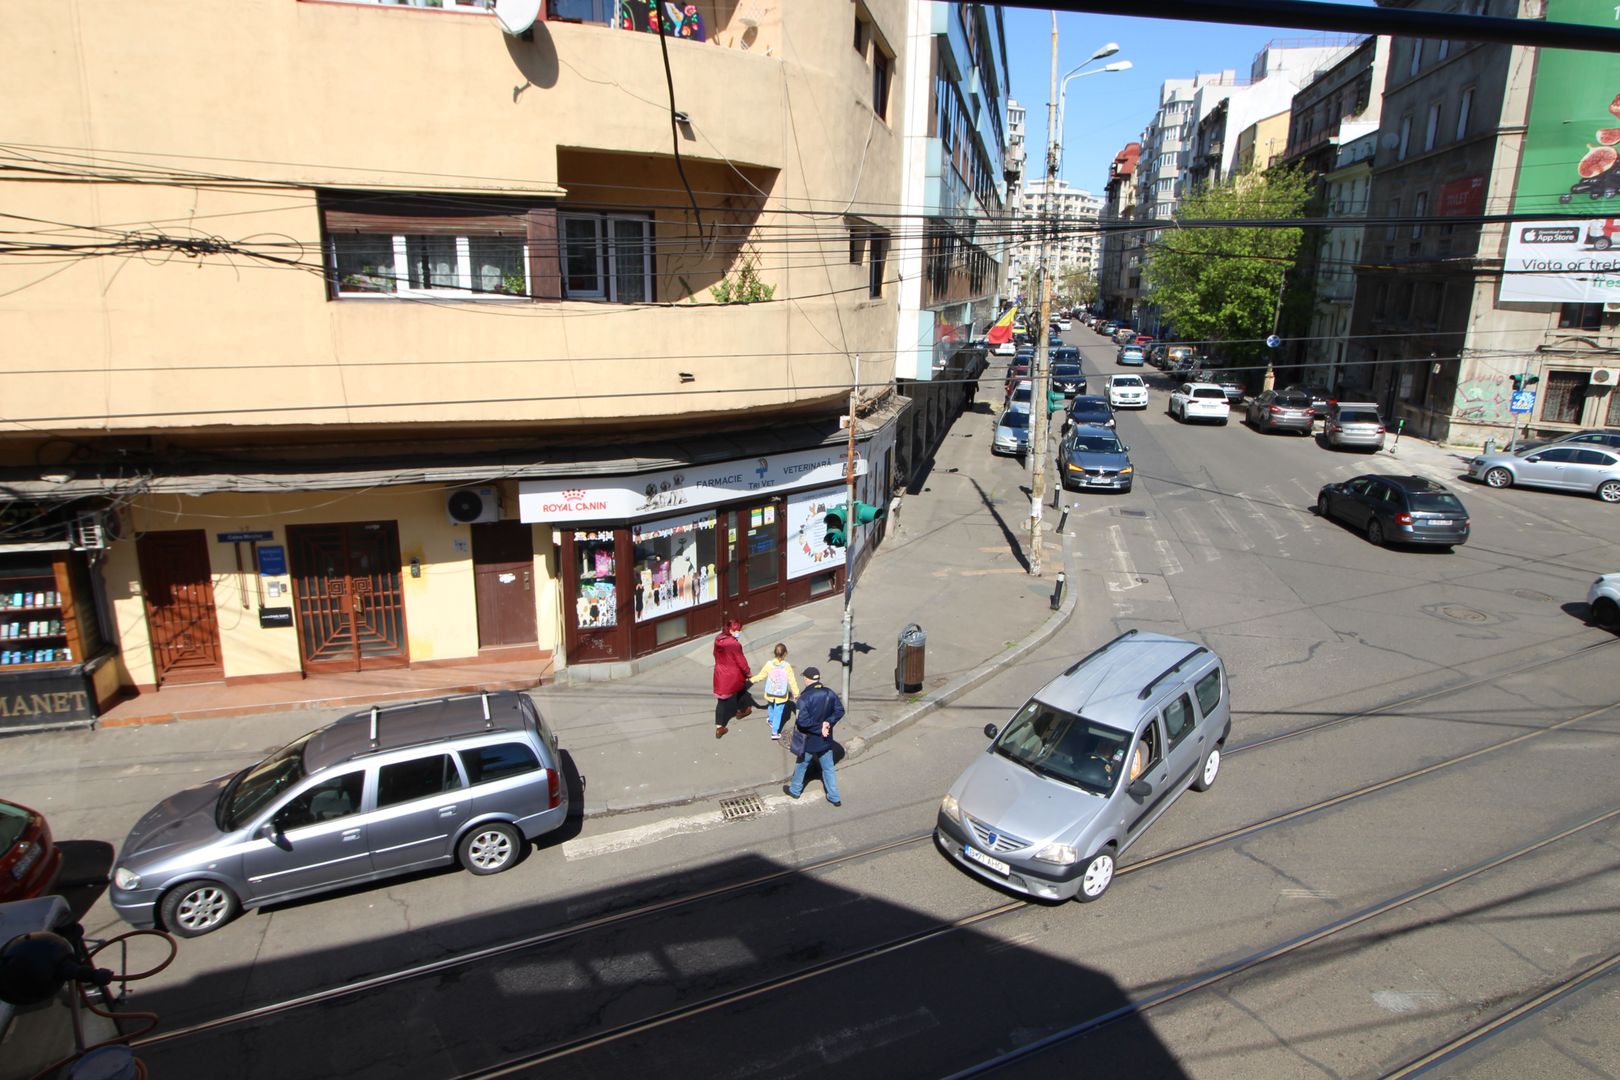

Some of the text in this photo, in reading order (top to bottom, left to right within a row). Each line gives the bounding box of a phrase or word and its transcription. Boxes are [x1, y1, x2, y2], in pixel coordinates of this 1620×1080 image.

[1536, 233, 1575, 243] App Store
[696, 473, 743, 489] FARMACIE
[543, 500, 607, 513] ROYAL CANIN
